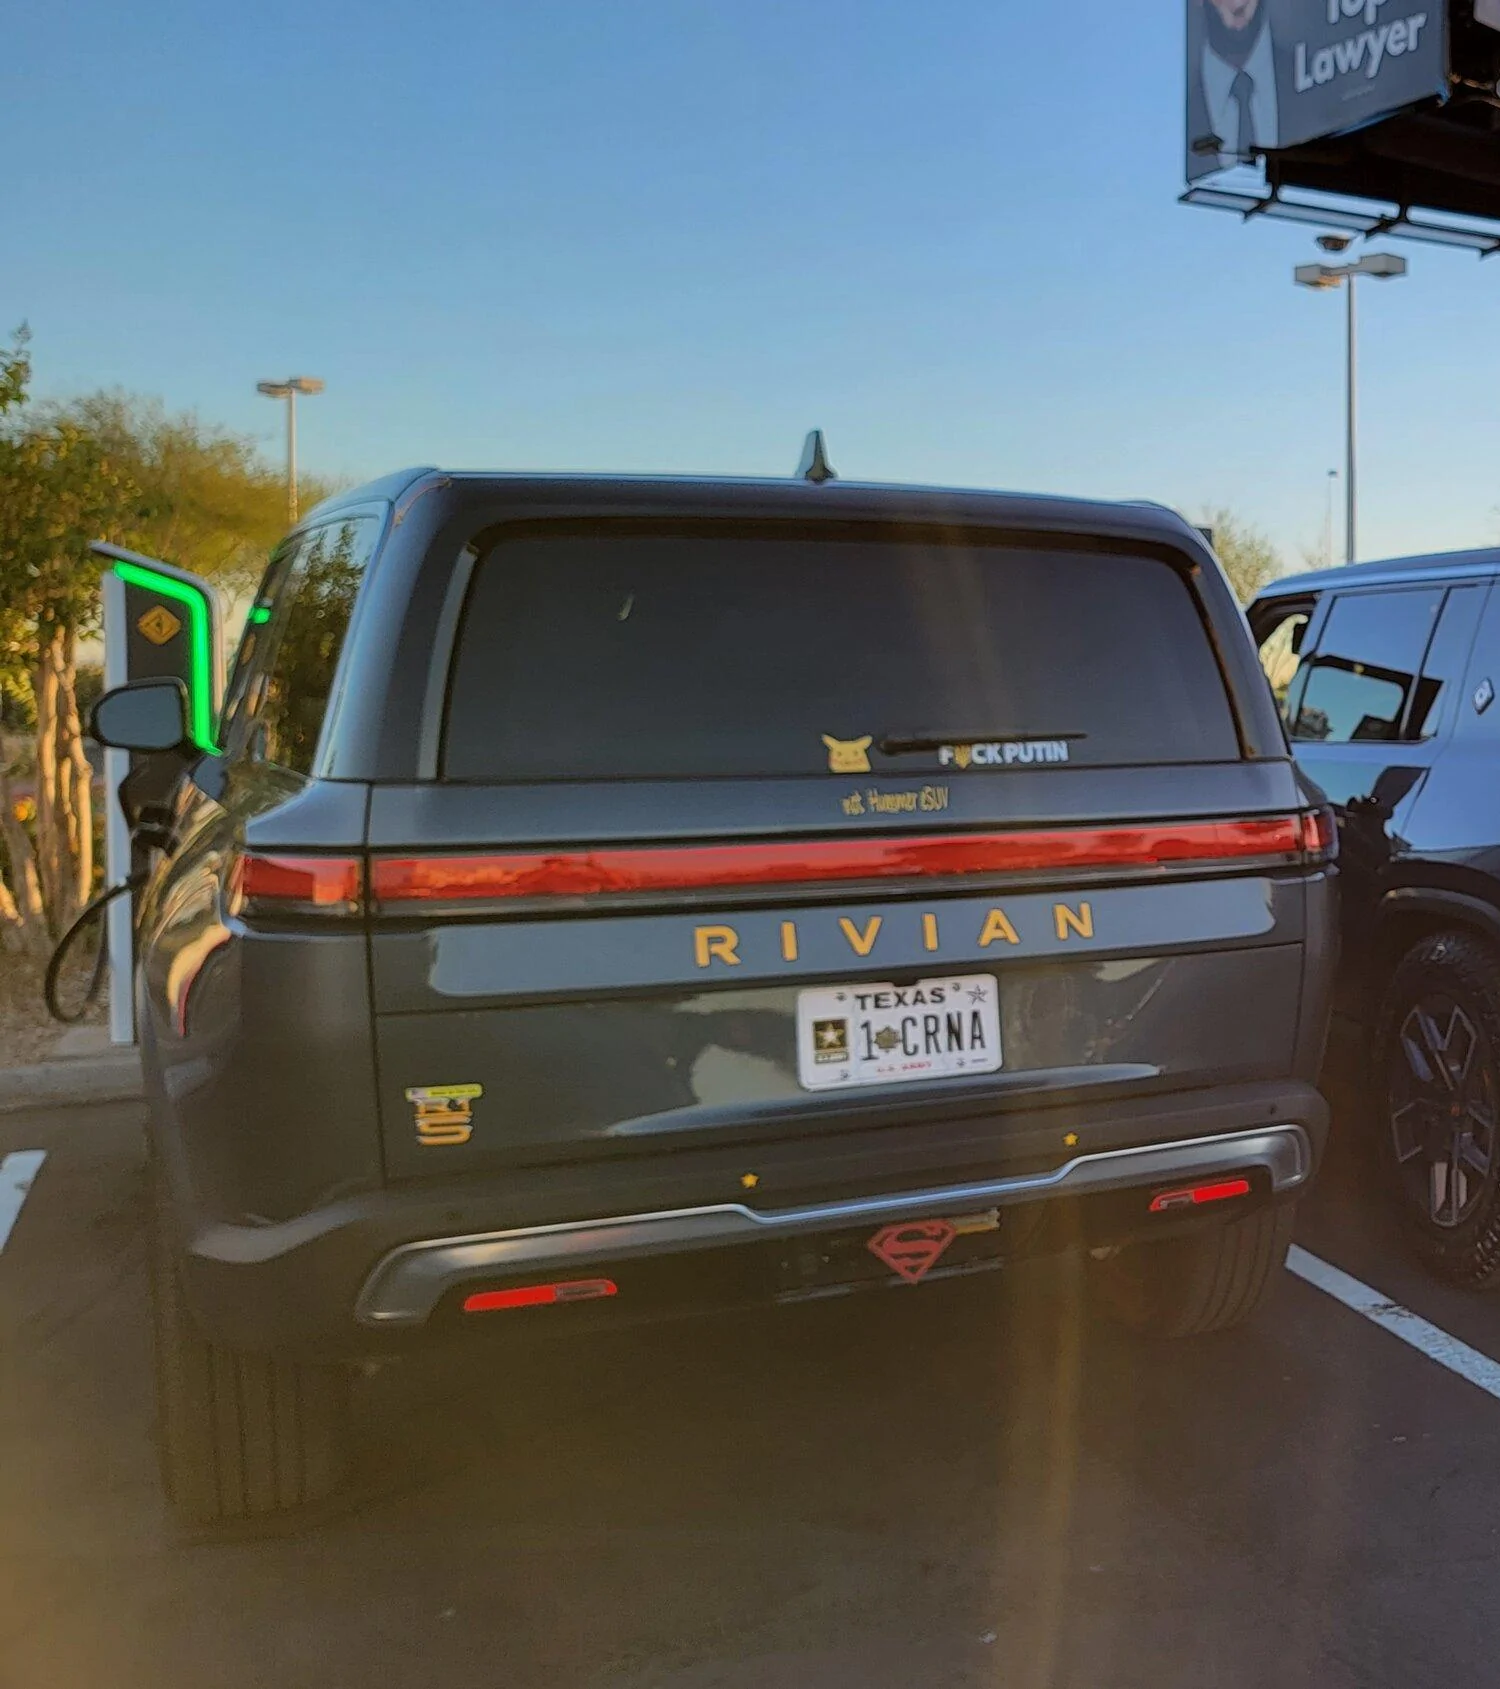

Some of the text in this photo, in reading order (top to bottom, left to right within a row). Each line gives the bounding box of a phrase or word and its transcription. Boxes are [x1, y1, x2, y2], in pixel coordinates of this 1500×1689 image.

[1294, 12, 1428, 93] Lawyer
[1004, 740, 1069, 764] PUTIN
[694, 902, 1095, 968] RIVIAN
[854, 987, 946, 1010] TEXAS
[860, 1009, 986, 1061] 1 CRNA
